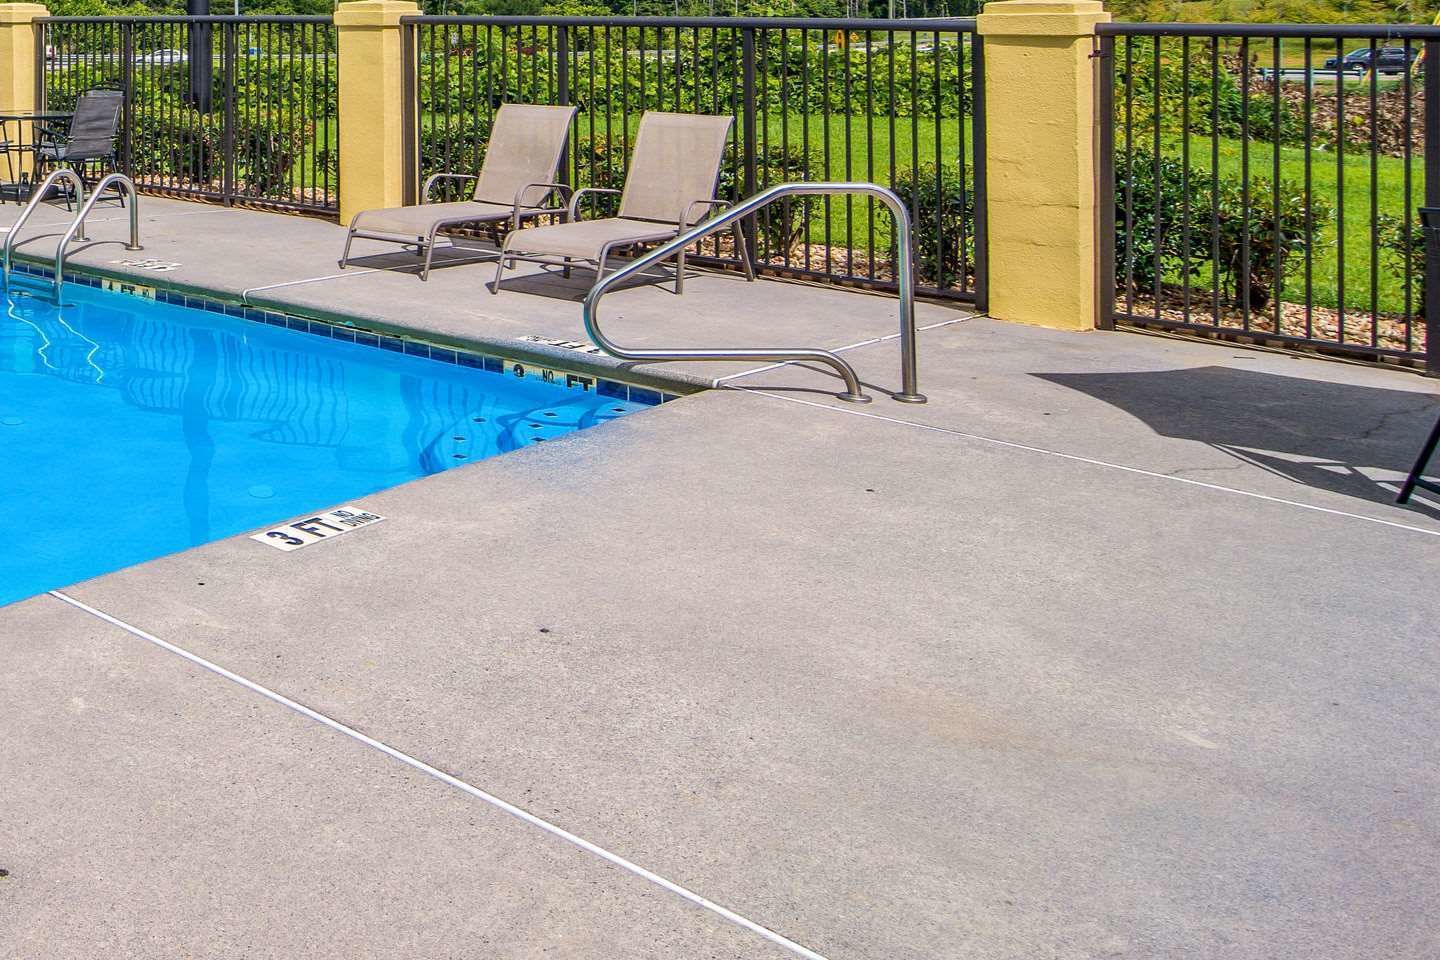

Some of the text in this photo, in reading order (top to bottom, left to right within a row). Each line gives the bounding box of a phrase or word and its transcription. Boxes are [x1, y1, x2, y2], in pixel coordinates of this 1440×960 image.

[566, 374, 593, 392] FT
[266, 517, 344, 546] 3 FT
